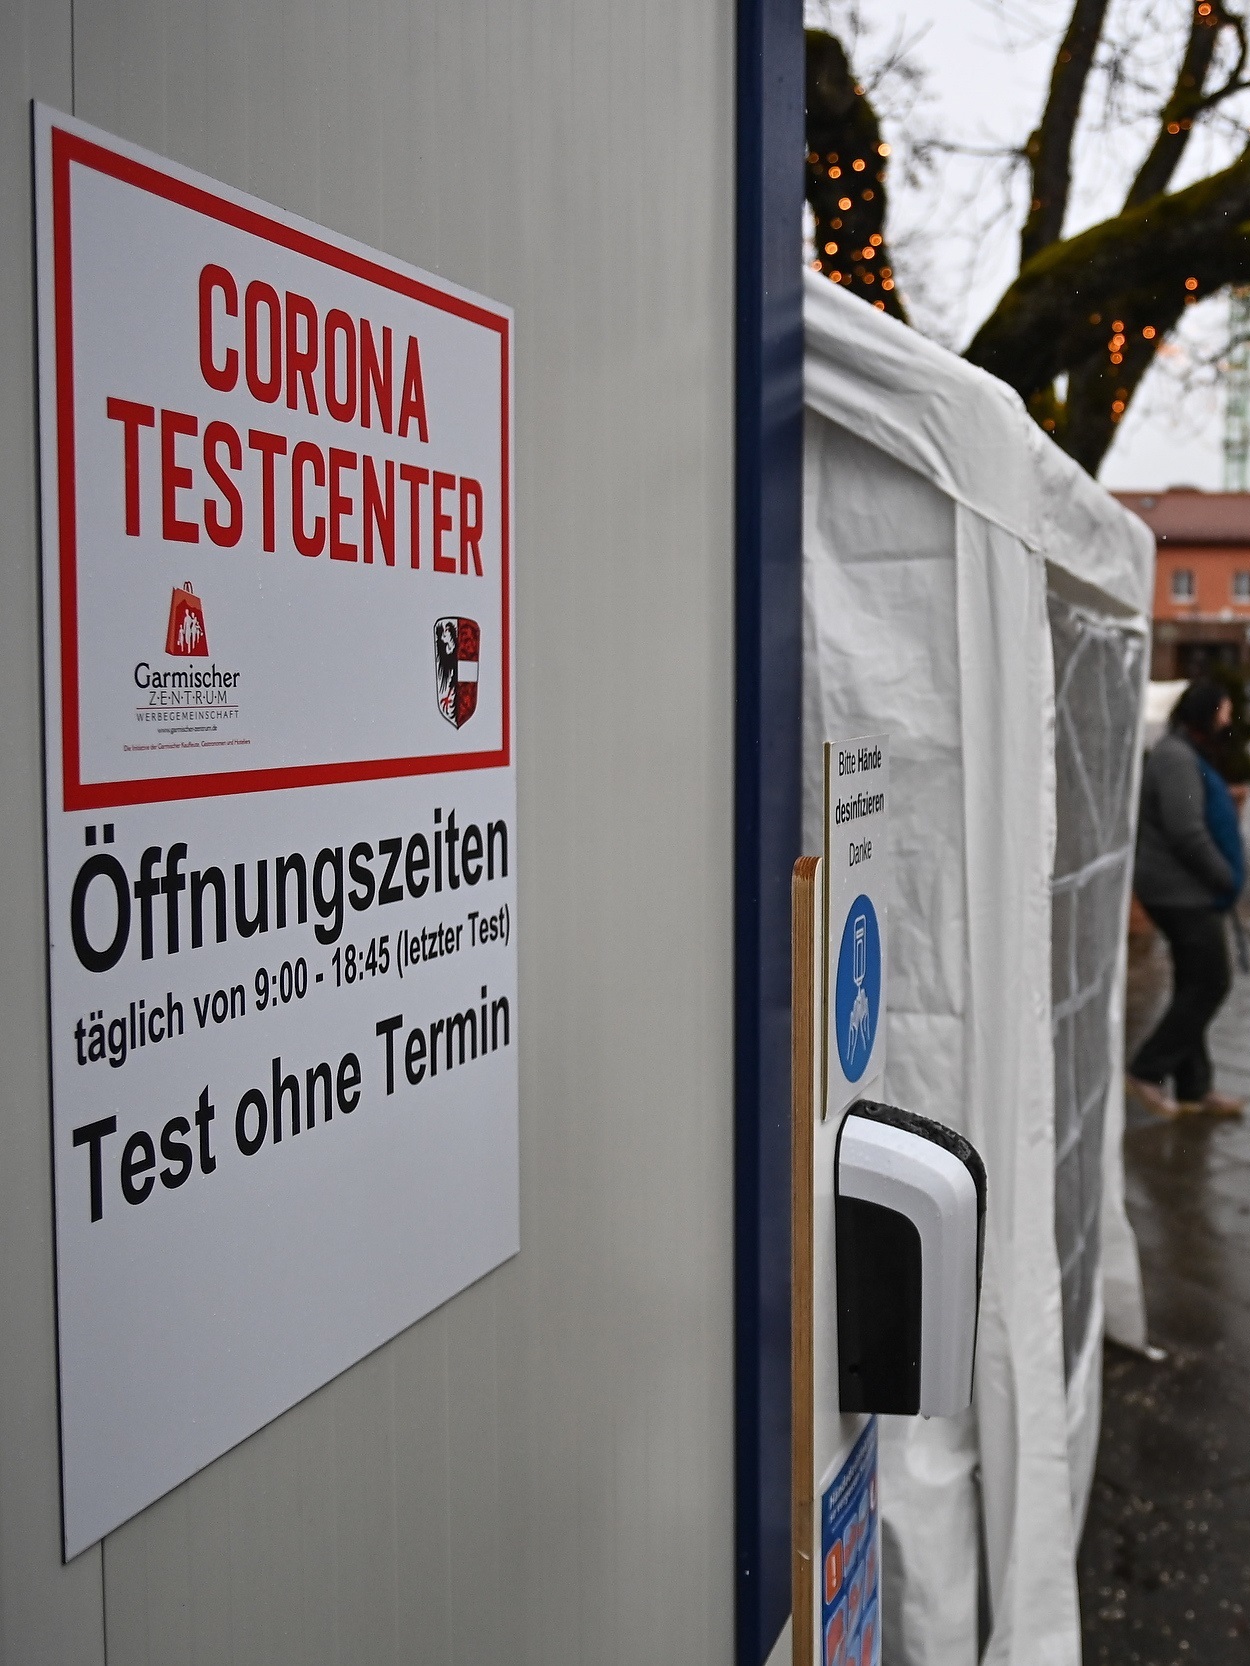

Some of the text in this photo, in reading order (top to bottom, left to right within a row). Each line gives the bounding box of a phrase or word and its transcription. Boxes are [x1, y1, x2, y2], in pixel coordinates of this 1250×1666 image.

[199, 263, 429, 443] CORONA
[106, 396, 484, 577] TESTCENTER
[134, 662, 240, 689] Garmischer
[136, 710, 239, 721] WERBEGEMEINSCHAFT
[835, 791, 885, 825] desinfizieren
[839, 745, 882, 776] Bitte Hände
[71, 807, 509, 973] Öffnungszeiten
[849, 837, 872, 867] Danke
[74, 993, 184, 1069] täglich
[193, 983, 246, 1029] von
[255, 957, 308, 1011] 9:00
[332, 935, 390, 987] 18:45
[396, 923, 463, 978] (letzter
[468, 904, 511, 947] Test)
[72, 985, 510, 1223] Test ohne Termin
